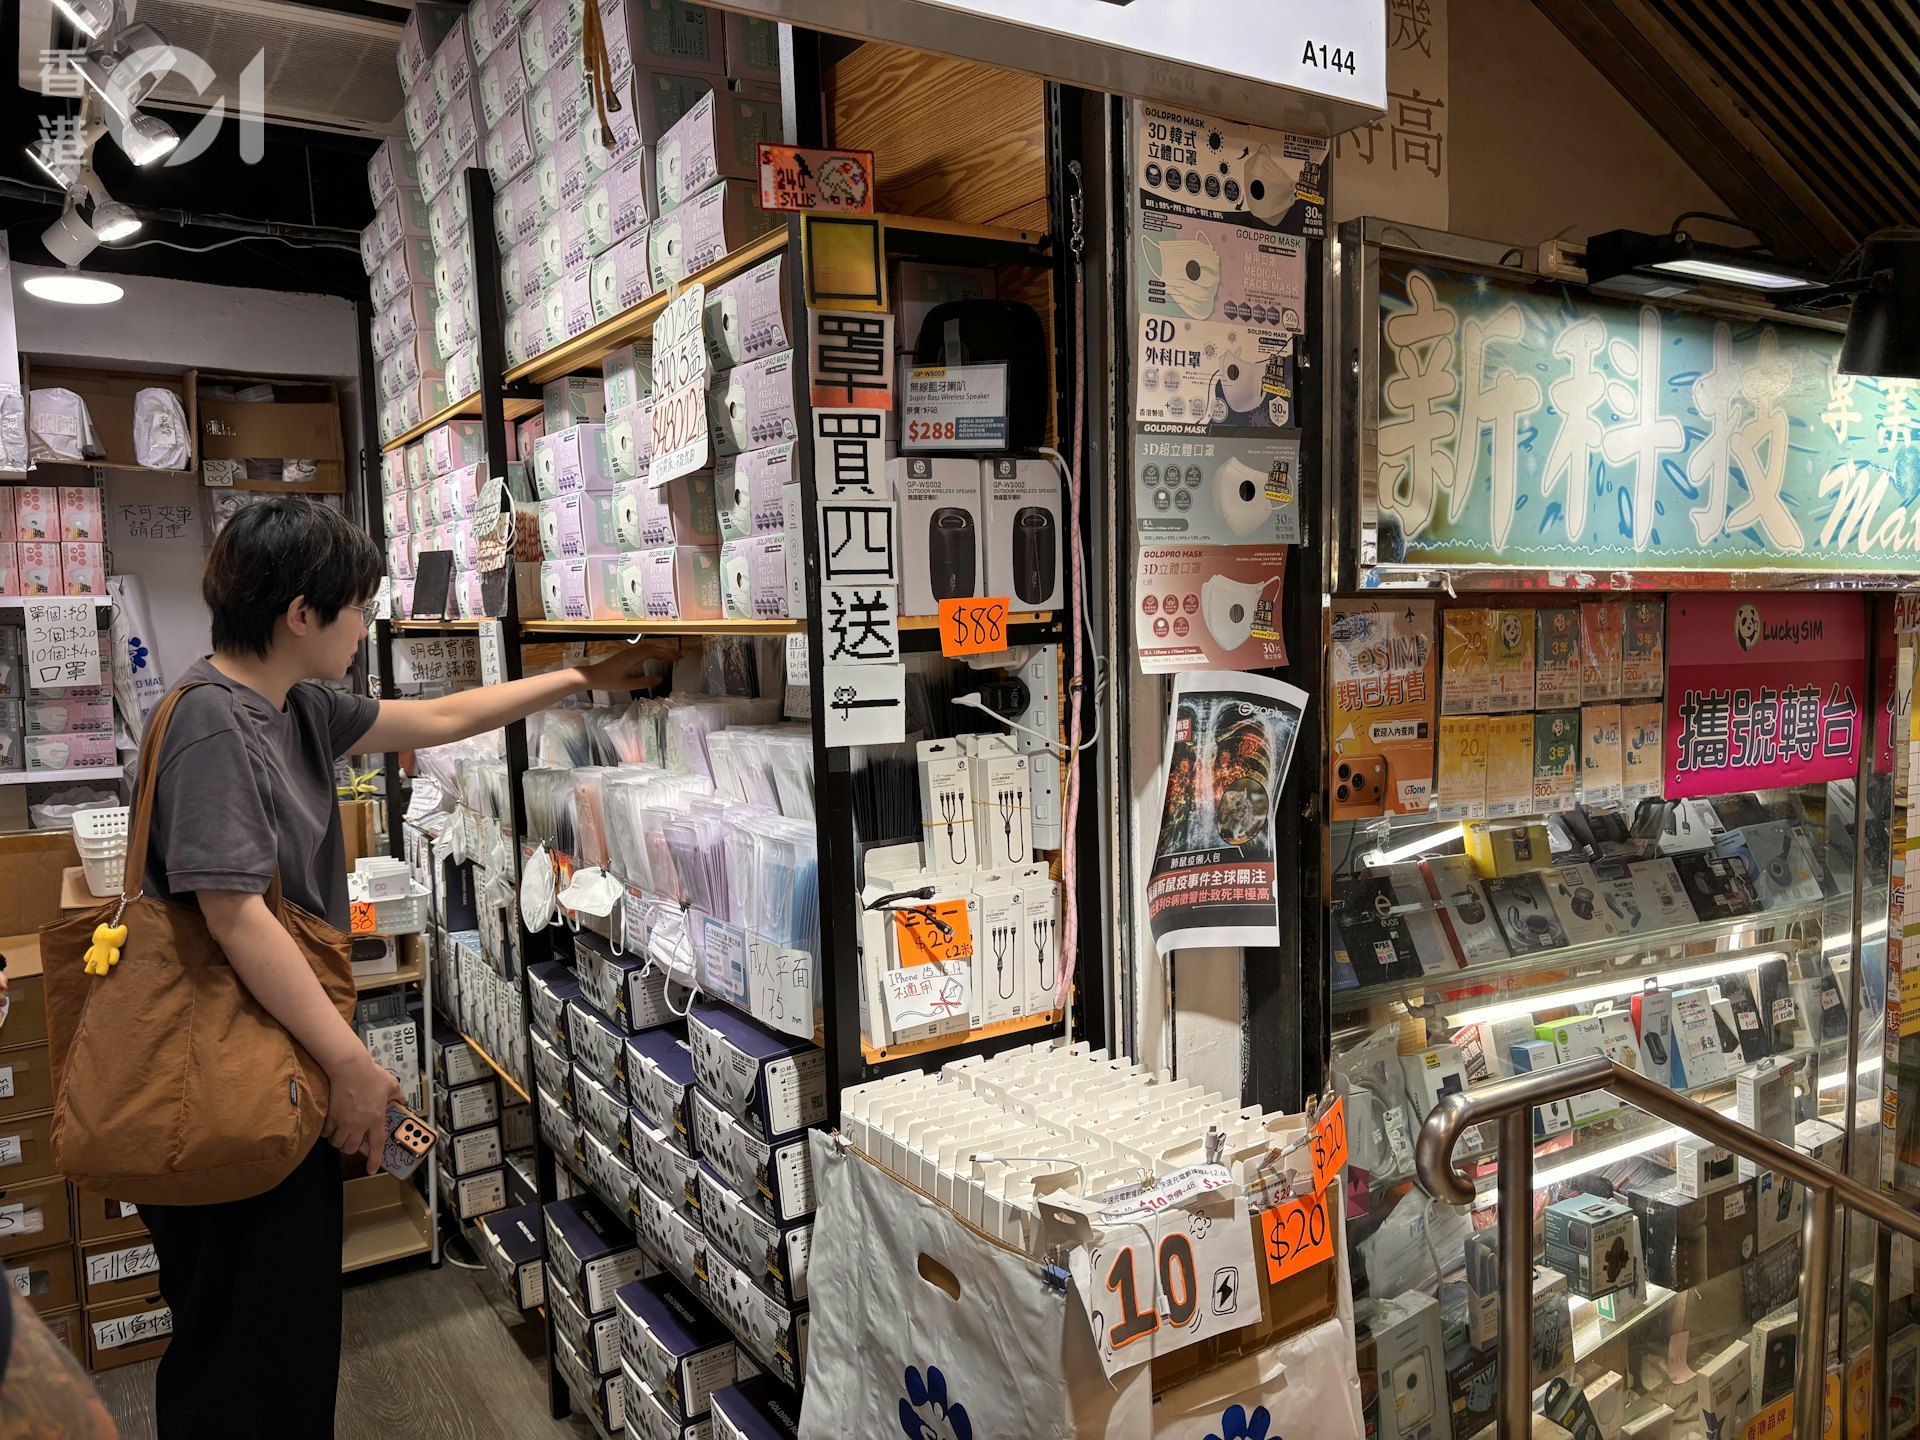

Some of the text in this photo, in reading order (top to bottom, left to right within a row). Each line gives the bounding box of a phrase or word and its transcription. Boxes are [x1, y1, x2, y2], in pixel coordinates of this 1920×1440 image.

[1302, 40, 1356, 75] A144
[1145, 107, 1205, 129] GOLDPRO MASK
[1148, 123, 1197, 149] 3D 韓式
[1147, 142, 1198, 167] 立體口罩
[1236, 229, 1301, 249] GOLDPRO MASK
[1243, 265, 1282, 280] MEDICAL
[1243, 277, 1298, 294] FACE MASK
[1145, 318, 1176, 343] 3D
[1247, 328, 1288, 339] GOLDPRO MASK
[753, 353, 791, 371] GOLDPRO MASK
[1145, 346, 1200, 368] 外科口罩
[909, 381, 967, 393] 無線藍牙喇叭
[909, 394, 924, 402] Super
[941, 393, 965, 401] Wireless
[966, 393, 990, 402] Speaker
[1139, 408, 1164, 418] 香港製造
[1379, 269, 1804, 553] 新科技
[908, 420, 955, 442] $288
[1143, 423, 1207, 434] GOLDPRO MASK
[1141, 442, 1216, 458] 3D超立體口罩
[205, 461, 227, 474] SS
[1144, 550, 1204, 558] GOLDPRO MASK
[1142, 562, 1201, 575] 3D立體口罩
[952, 604, 1004, 647] $88
[1332, 611, 1375, 643] 全球
[411, 638, 476, 660] 明碼實價
[1552, 641, 1569, 655] 3年
[39, 662, 87, 682] 口罩
[411, 660, 478, 681] 謝絕議價
[1336, 670, 1426, 713] 現已有售
[1373, 726, 1415, 738] 歡迎入內查詢
[1676, 682, 1858, 771] 攜號轉台
[1549, 746, 1565, 761] 3年
[1170, 852, 1221, 869] 肺鼠疫懶人包
[904, 905, 958, 929] 三合一
[894, 981, 934, 1000] 不適用
[761, 986, 784, 1020] 175
[1584, 1023, 1600, 1034] belkin
[392, 1027, 416, 1062] 3D 外科口罩
[1315, 1111, 1344, 1179] $20
[1273, 1184, 1292, 1204] $20
[1269, 1202, 1325, 1267] $20
[1107, 1232, 1198, 1348] 10
[767, 1400, 793, 1430] GOLDPRO
[1747, 1407, 1787, 1440] 香港品牌
